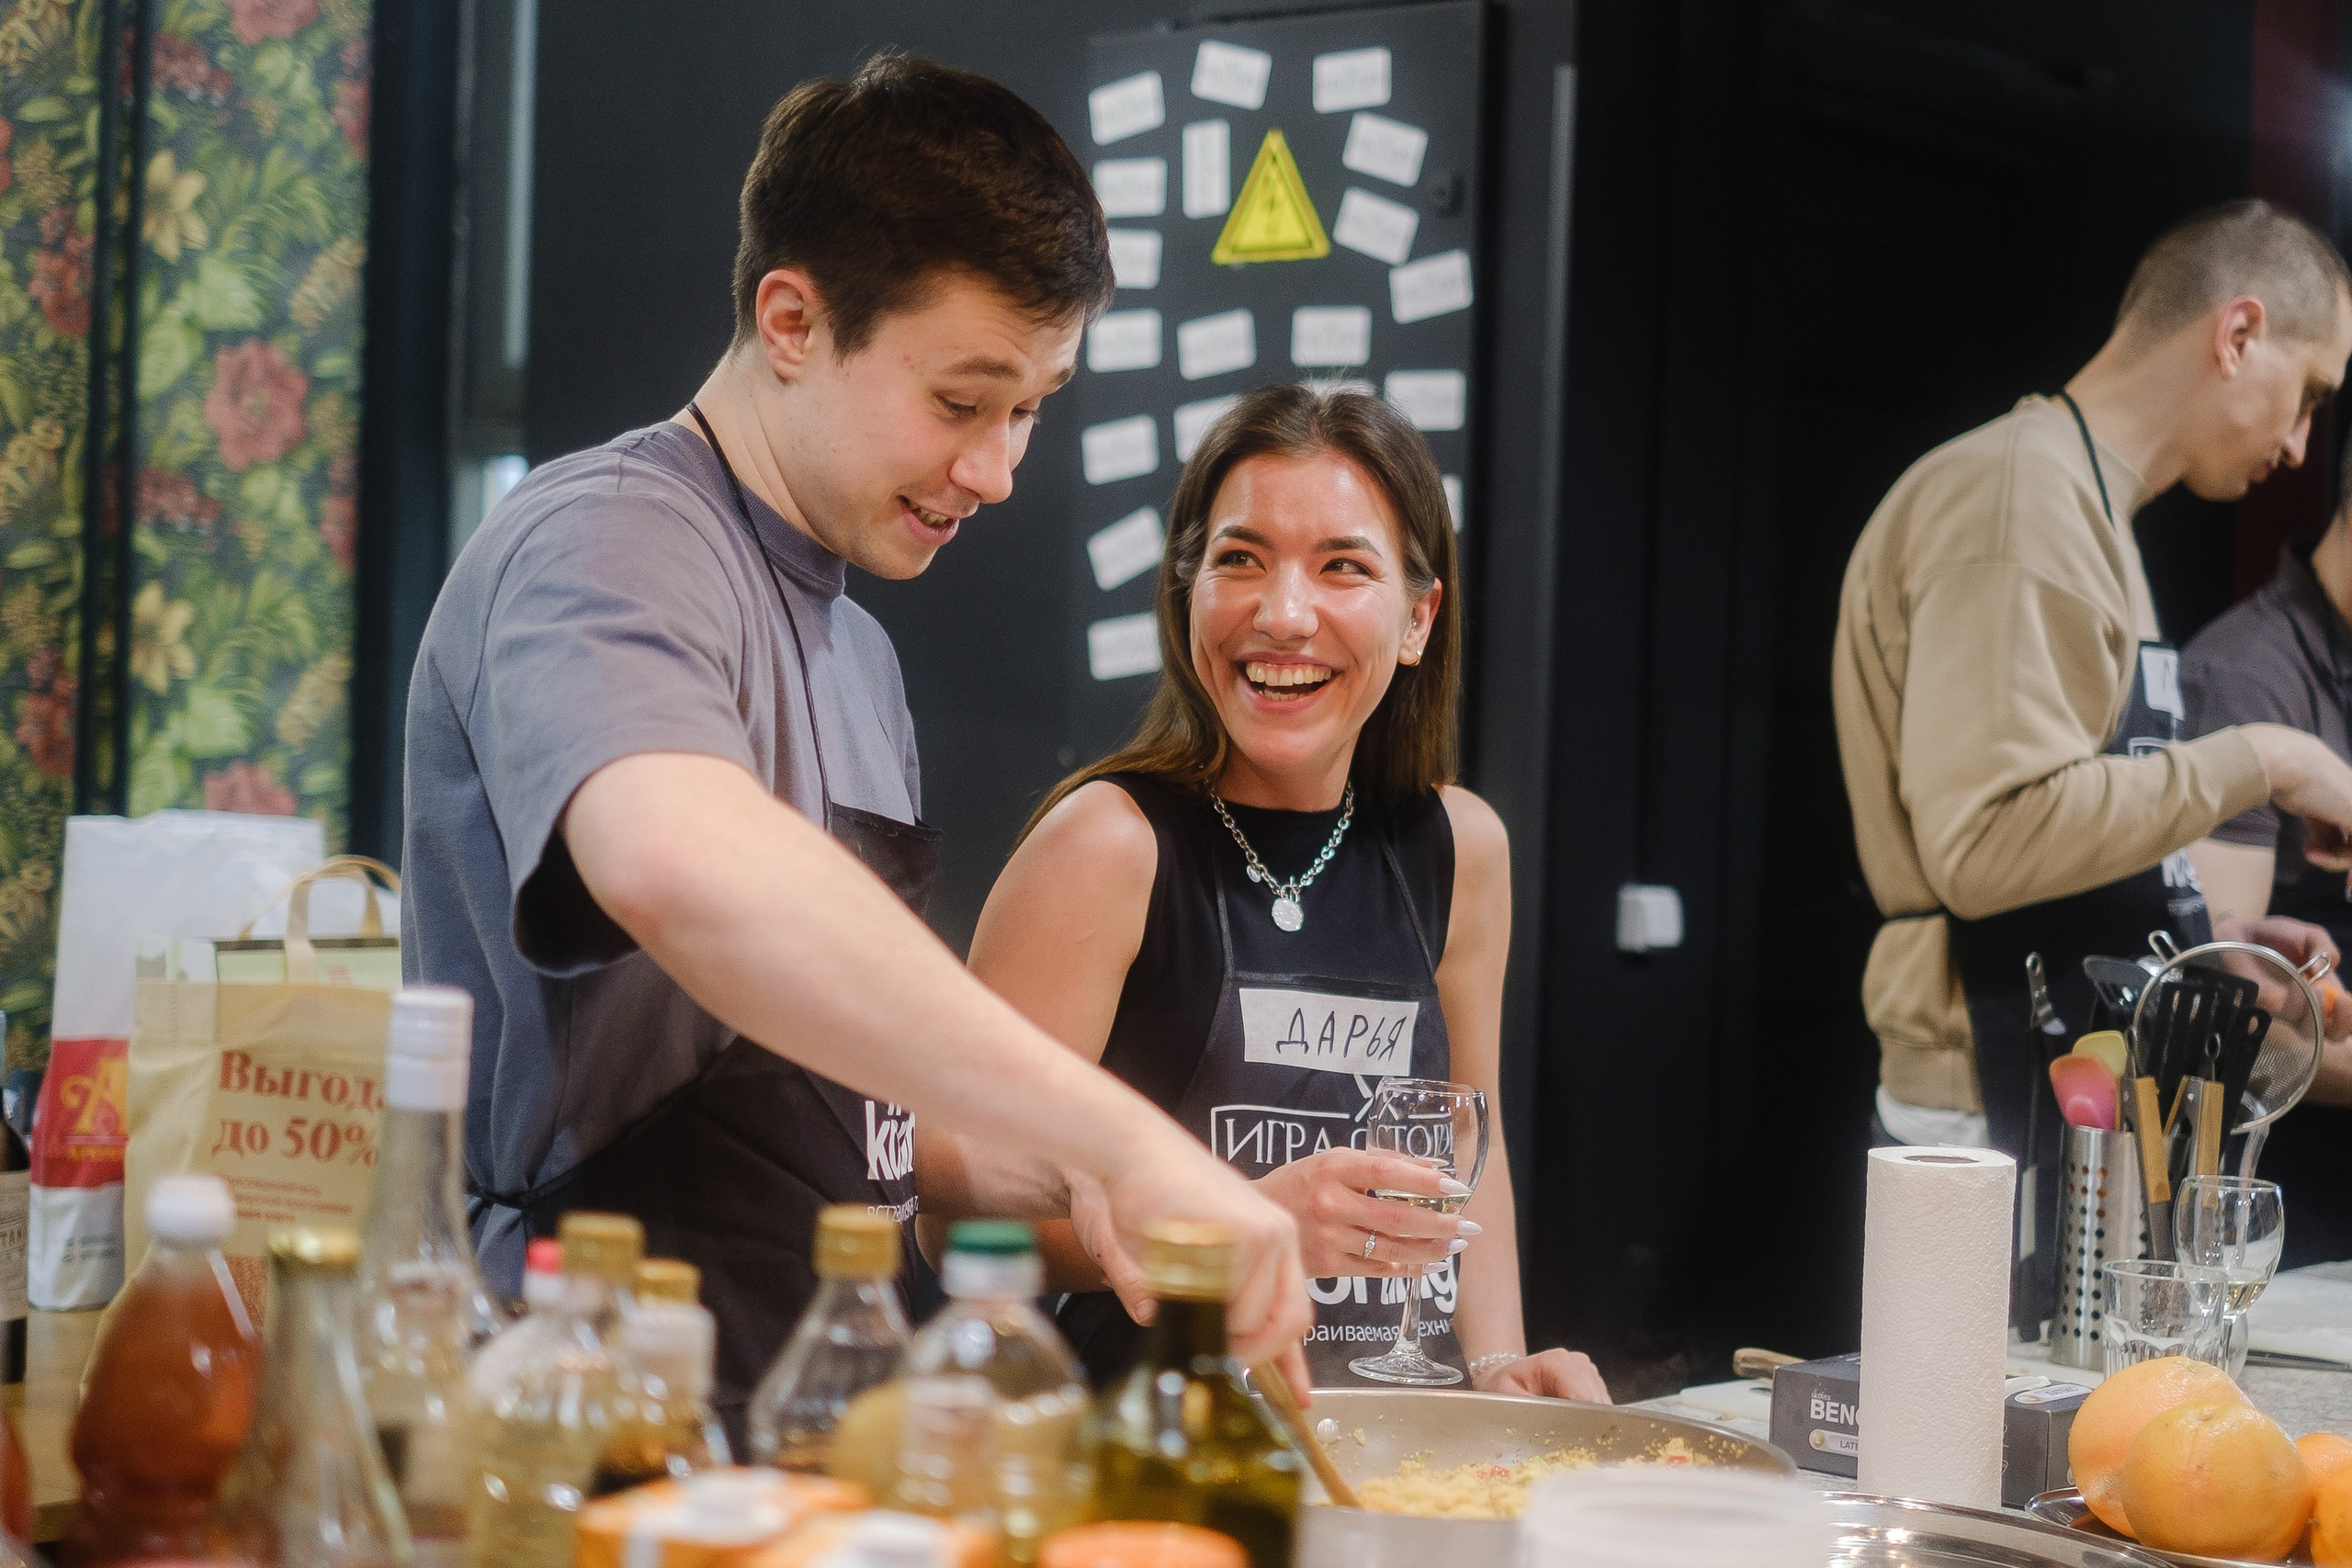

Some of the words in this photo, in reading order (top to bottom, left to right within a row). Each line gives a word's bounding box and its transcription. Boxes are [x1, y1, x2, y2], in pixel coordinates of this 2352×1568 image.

[1275, 1007, 1408, 1062] ДАРЬЯ
[219, 1048, 386, 1113] Выгод
[210, 1117, 270, 1161] до
[280, 1114, 380, 1168] 50%
[1225, 1118, 1332, 1165] ИГРА
[1303, 1325, 1401, 1347] раиваемая
[1810, 1398, 1860, 1426] BEN
[1839, 1439, 1860, 1451] LATE
